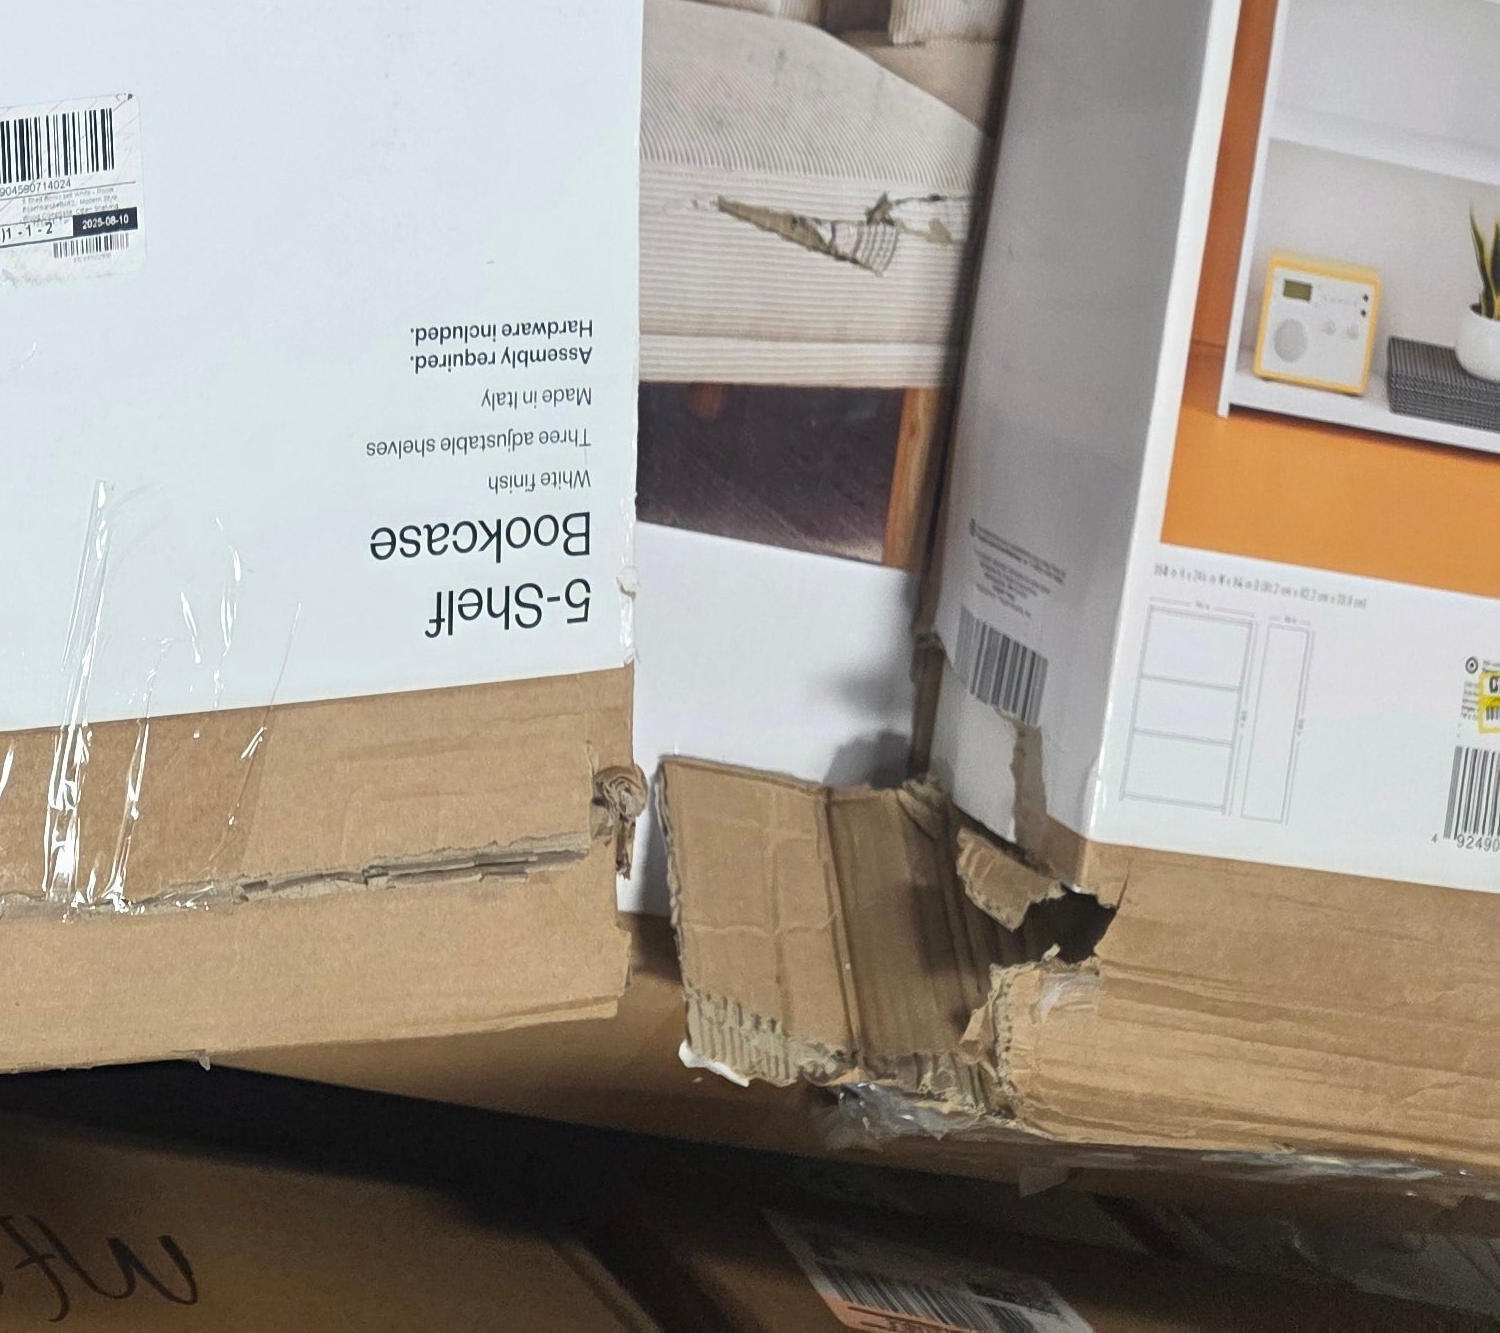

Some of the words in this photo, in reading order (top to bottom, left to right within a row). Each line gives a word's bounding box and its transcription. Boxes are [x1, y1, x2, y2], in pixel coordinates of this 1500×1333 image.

[410, 324, 497, 347] included.
[501, 320, 593, 343] Hardware
[410, 349, 497, 375] required.
[500, 346, 593, 370] Assembly
[480, 389, 518, 412] Italy
[523, 389, 538, 409] in
[542, 387, 592, 408] Made
[366, 439, 436, 460] shelves
[440, 429, 535, 456] adjustable
[538, 429, 591, 449] Three
[488, 473, 536, 495] finish
[540, 469, 591, 492] White
[370, 512, 590, 564] Bookcase
[425, 579, 591, 639] 5-Shelf
